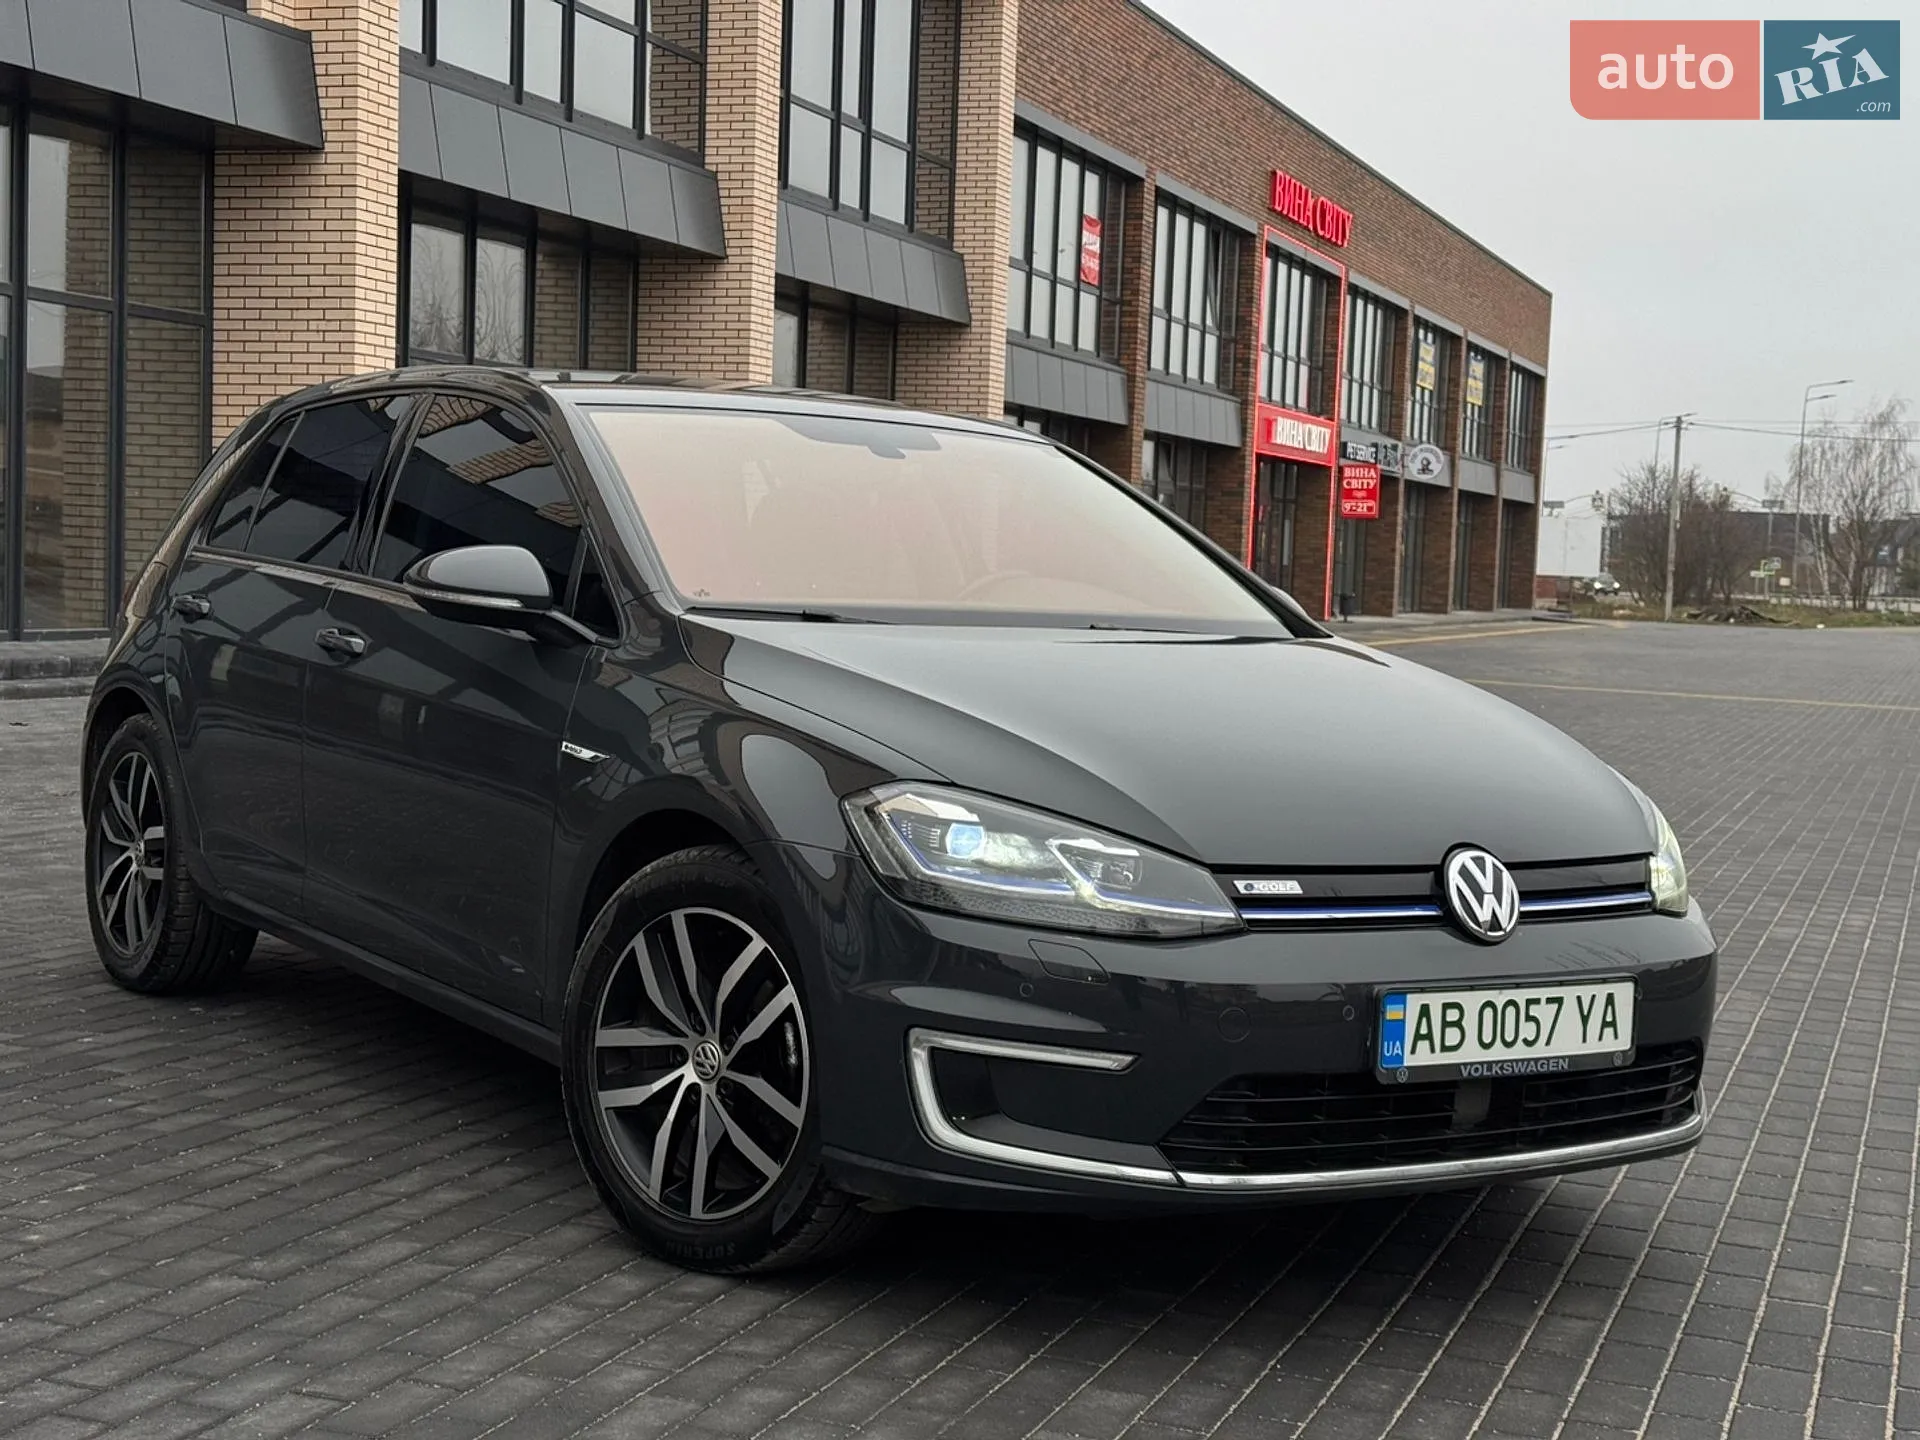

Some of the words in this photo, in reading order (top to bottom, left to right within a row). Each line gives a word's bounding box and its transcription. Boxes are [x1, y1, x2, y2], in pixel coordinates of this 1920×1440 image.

[1274, 169, 1313, 232] ВИНА
[1316, 195, 1353, 248] СВІТУ
[1276, 416, 1304, 449] ВИНА
[1305, 424, 1332, 454] СВІТУ
[1344, 467, 1377, 478] ВИНА
[1343, 479, 1377, 490] СВІТУ
[1410, 1001, 1466, 1055] AB
[1477, 996, 1565, 1050] 0057
[1575, 992, 1619, 1044] YA
[1384, 1041, 1402, 1056] UA
[1460, 1058, 1569, 1077] VOLKSWAGEN
